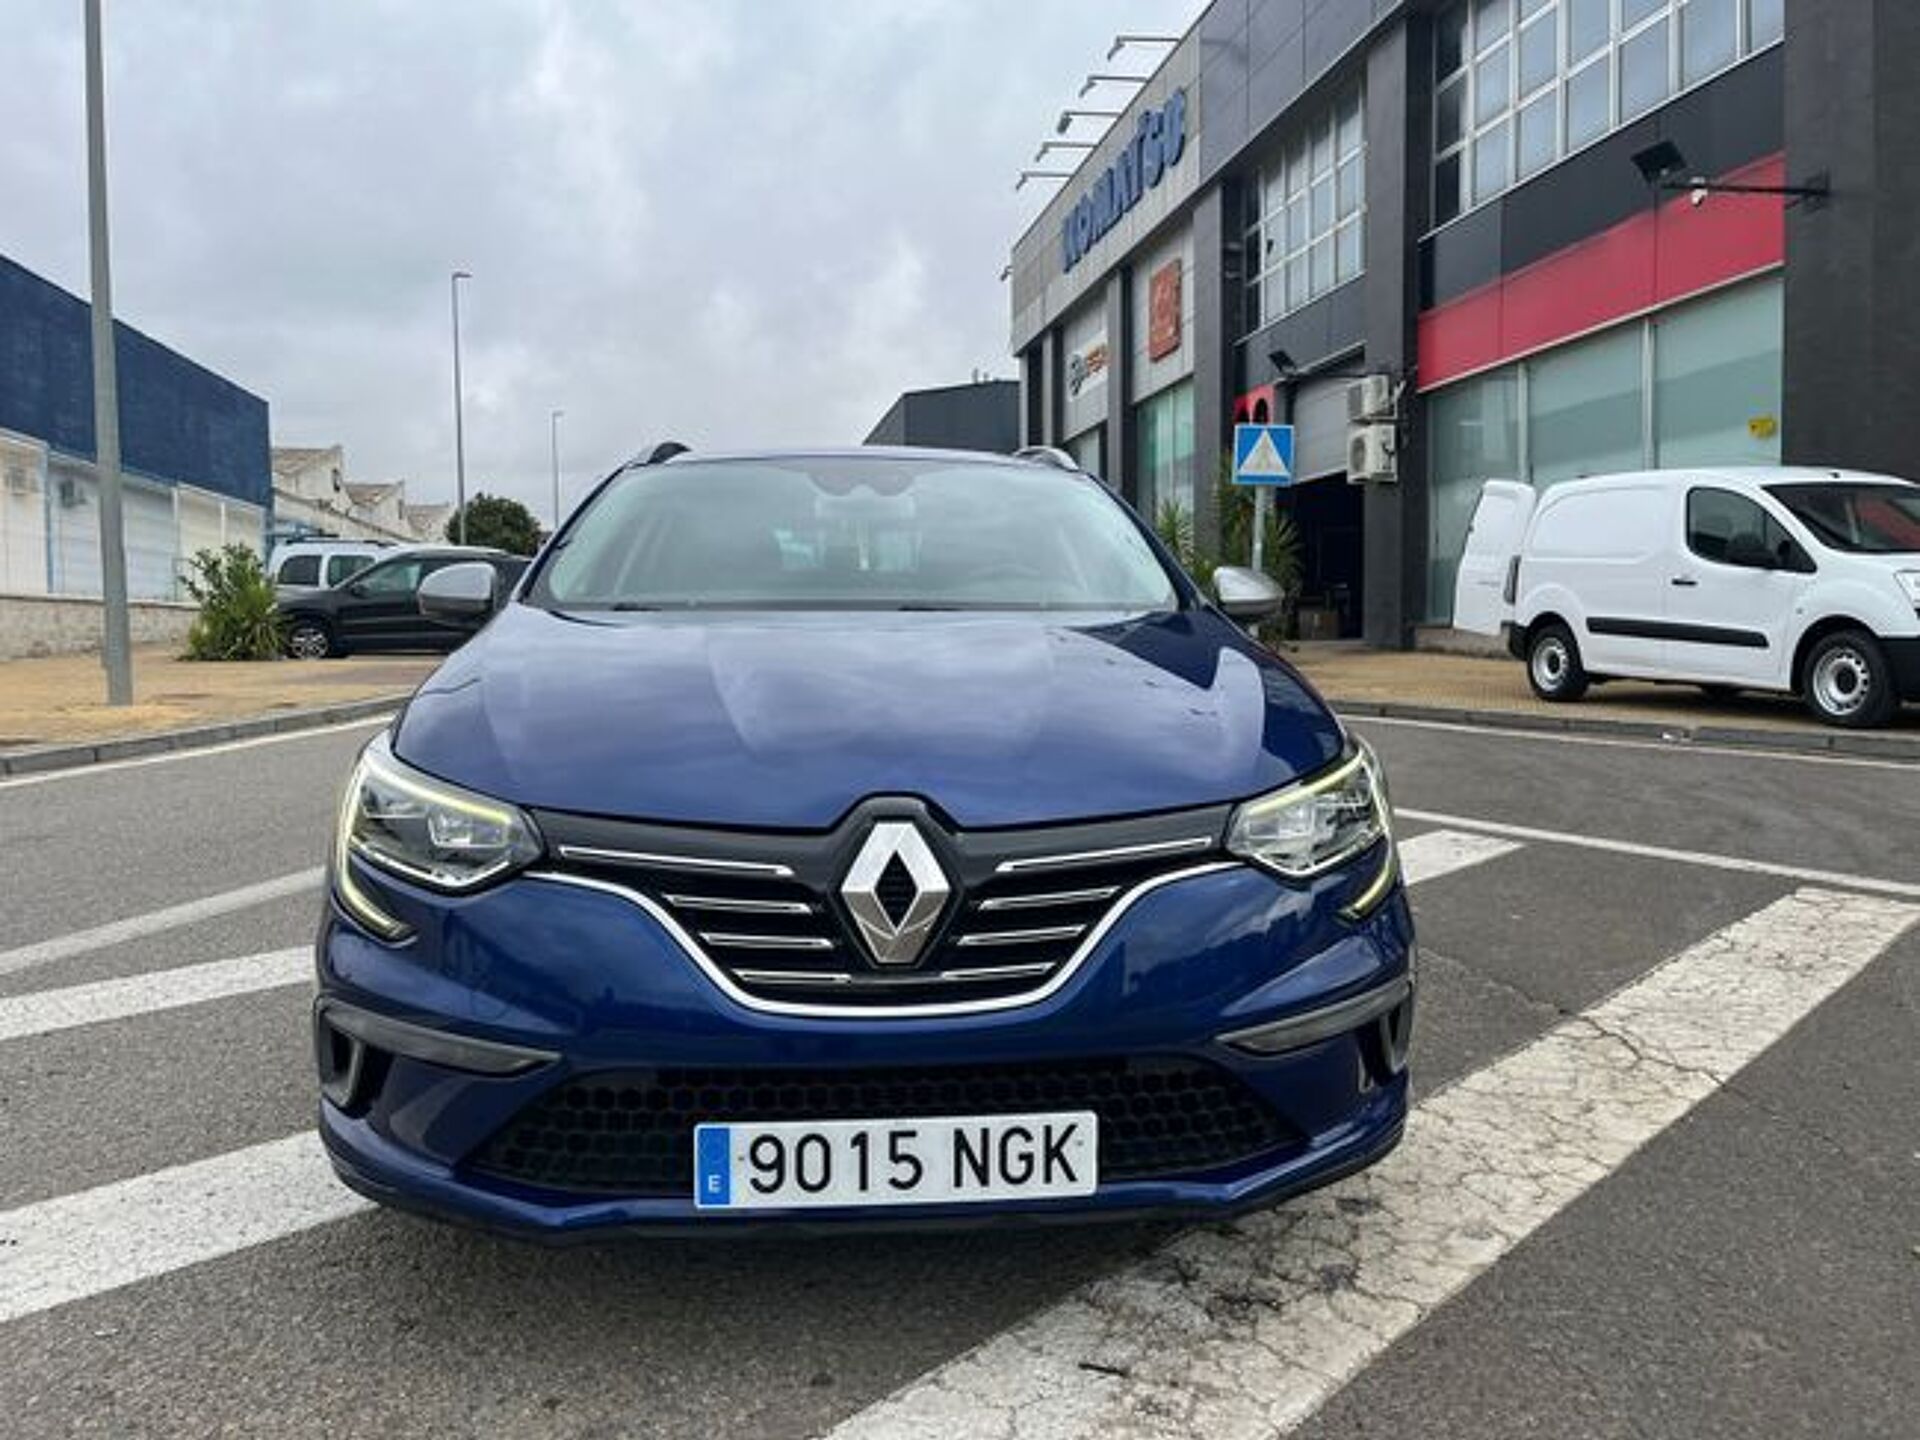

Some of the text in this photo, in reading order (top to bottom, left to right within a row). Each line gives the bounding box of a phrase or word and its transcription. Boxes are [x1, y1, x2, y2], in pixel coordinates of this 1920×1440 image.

[1062, 87, 1186, 273] KOMATSU
[708, 1174, 722, 1194] E
[749, 1122, 1078, 1194] 9015 NGK
